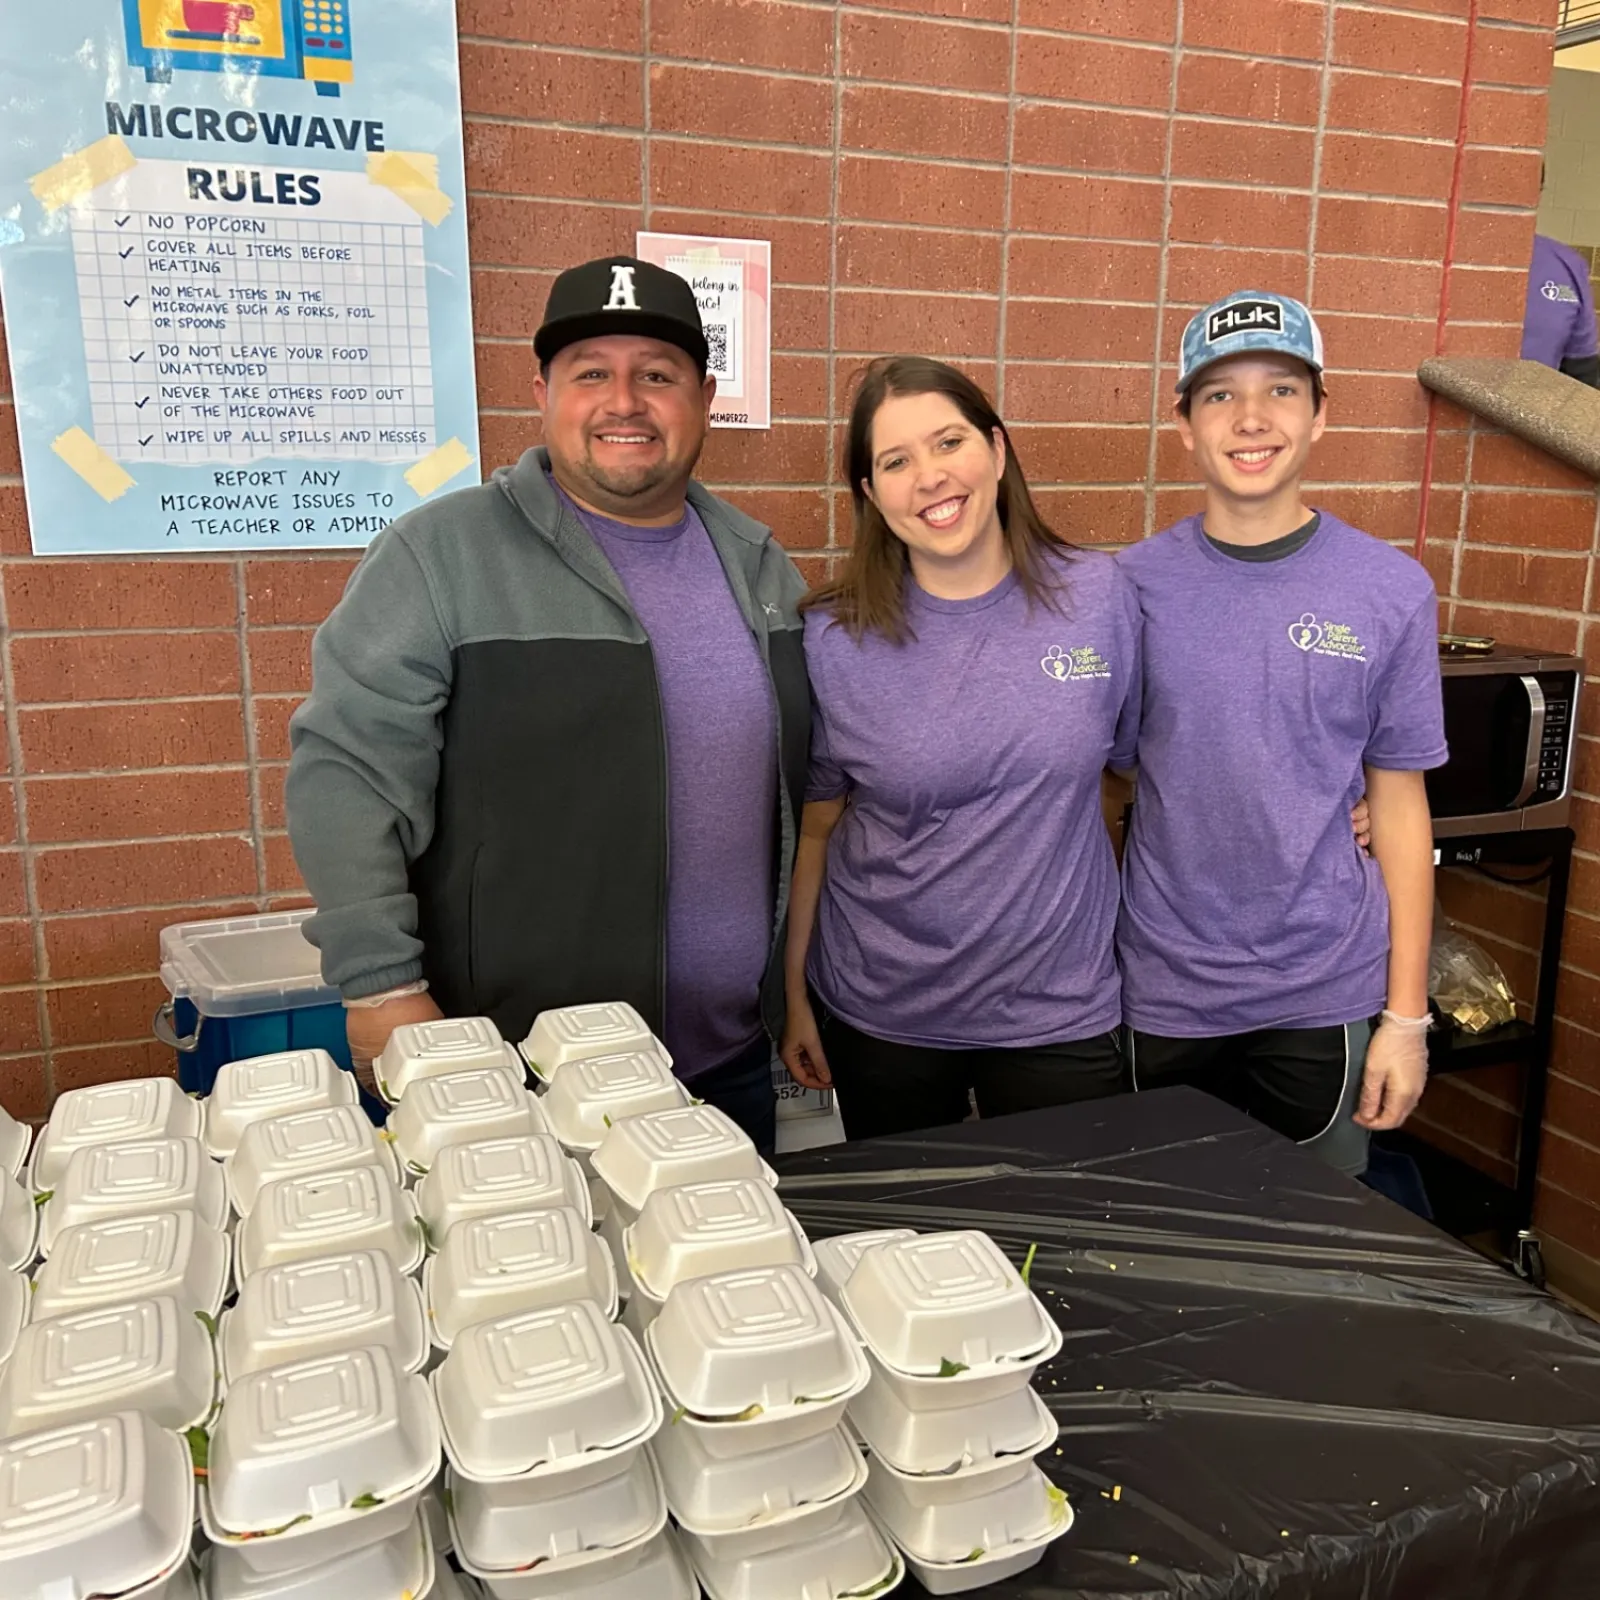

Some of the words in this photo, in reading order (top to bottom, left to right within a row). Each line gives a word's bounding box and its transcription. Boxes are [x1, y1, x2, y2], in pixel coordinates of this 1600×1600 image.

[105, 102, 386, 152] MICROWAVE
[187, 168, 322, 206] RULES
[148, 215, 174, 230] NO
[186, 216, 266, 234] POPCORN
[147, 240, 196, 254] COVER
[206, 243, 236, 256] ALL
[247, 244, 292, 258] ITEMS
[301, 247, 352, 260] BEFORE
[149, 258, 222, 274] HEATING
[602, 265, 642, 310] A
[692, 276, 724, 293] belong
[728, 281, 740, 292] in
[151, 286, 170, 297] NO
[177, 286, 222, 299] METAL
[229, 288, 268, 300] ITEMS
[275, 290, 292, 301] IN
[299, 290, 322, 302] THE
[153, 301, 230, 314] MICROWAVE
[236, 303, 268, 316] SUCH
[275, 304, 290, 316] AS
[298, 306, 339, 319] FORKS,
[347, 308, 376, 318] FOIL
[154, 318, 172, 328] OR
[178, 318, 226, 329] SPOONS
[158, 344, 180, 357] DO
[189, 344, 222, 358] NOT
[231, 346, 278, 359] LEAVE
[287, 347, 324, 360] YOUR
[332, 348, 369, 360] FOOD
[159, 363, 268, 376] UNATTENDED
[162, 386, 211, 399] NEVER
[219, 386, 260, 400] TAKE
[268, 387, 323, 400] OTHERS
[332, 388, 368, 400] FOOD
[375, 388, 405, 400] OUT
[164, 406, 182, 418] OF
[191, 405, 221, 418] THE
[229, 406, 316, 418] MICROWAVE
[166, 430, 205, 443] WIPE
[214, 431, 232, 443] UP
[241, 431, 271, 443] ALL
[279, 430, 332, 443] SPILLS
[340, 431, 372, 443] AND
[379, 430, 428, 443] MESSES
[213, 470, 288, 487] REPORT
[300, 470, 341, 487] ANY
[160, 494, 280, 512] MICROWAVE
[292, 492, 356, 510] ISSUES
[367, 492, 394, 508] TO
[166, 520, 179, 536] A
[191, 518, 280, 536] TEACHER
[292, 518, 316, 532] OR
